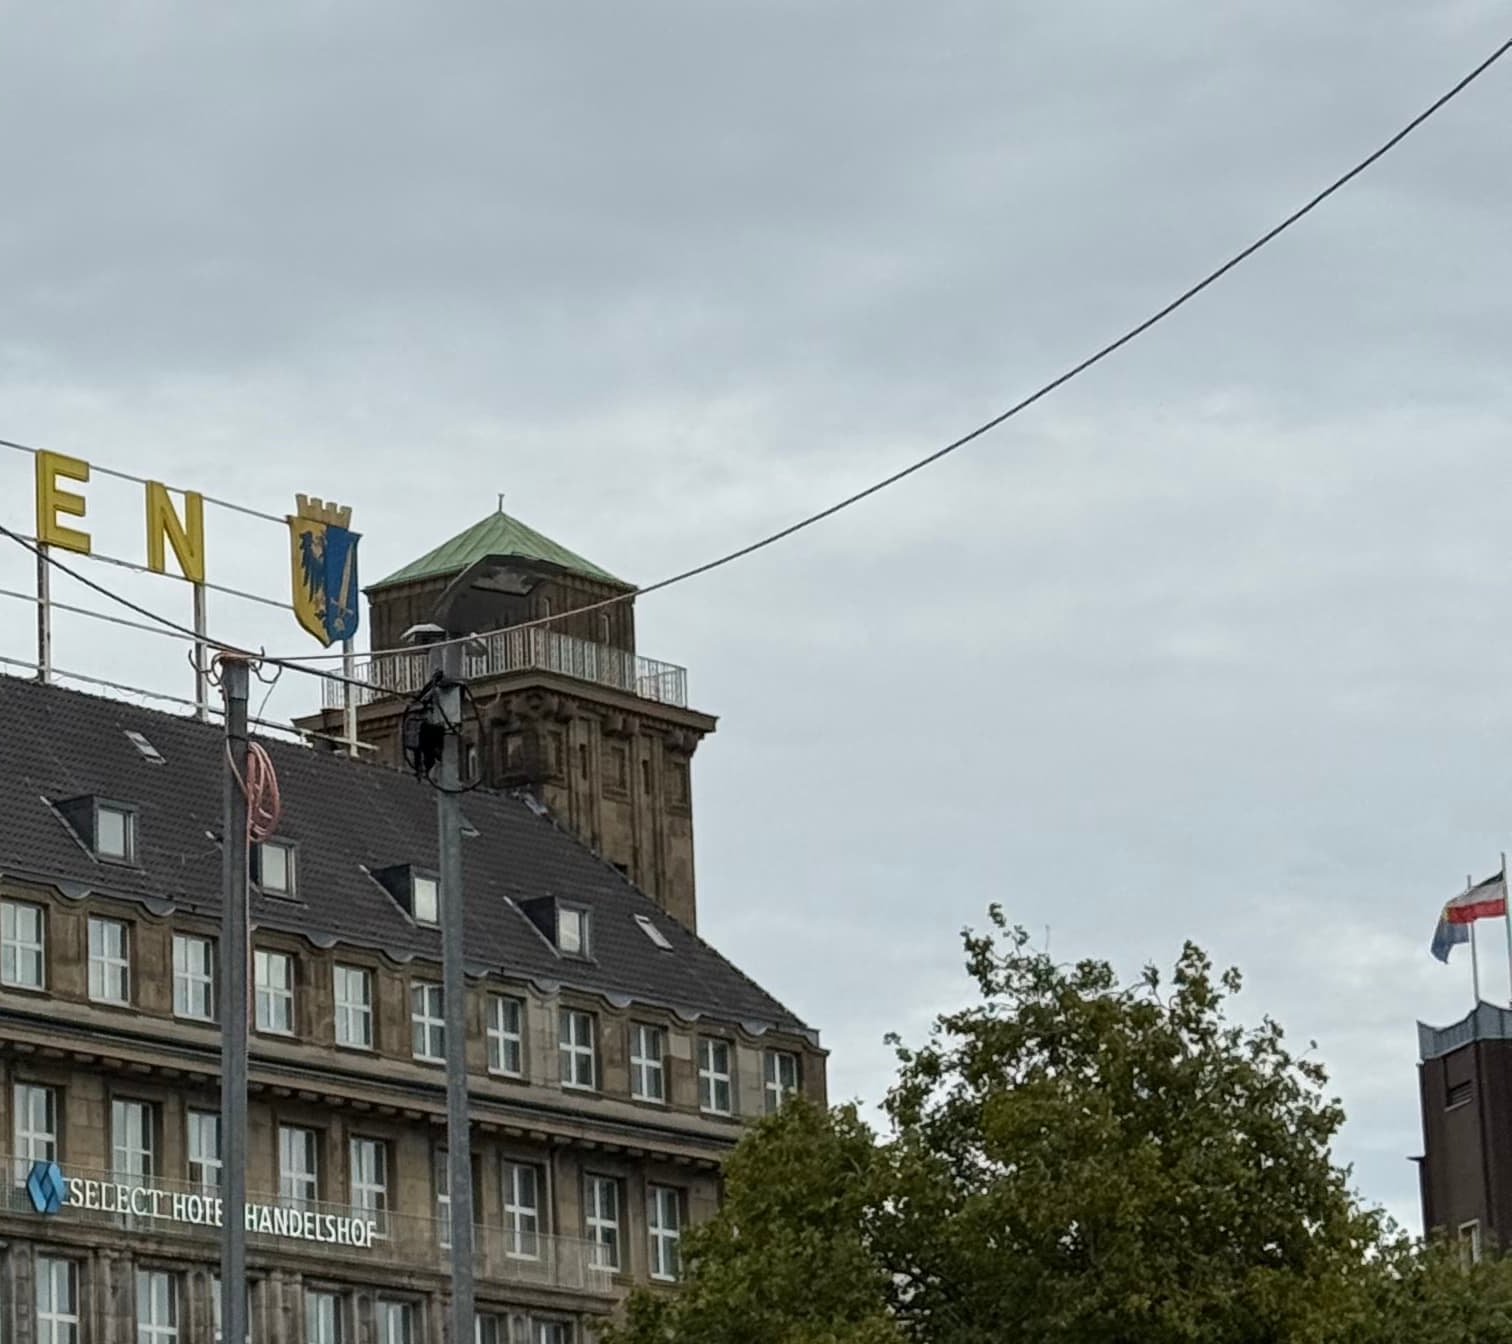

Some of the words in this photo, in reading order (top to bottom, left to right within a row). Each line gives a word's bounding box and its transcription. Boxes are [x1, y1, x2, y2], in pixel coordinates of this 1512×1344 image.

[69, 1177, 165, 1217] SELECT
[172, 1194, 223, 1226] HOTE
[245, 1203, 378, 1248] HANDELSHOF
